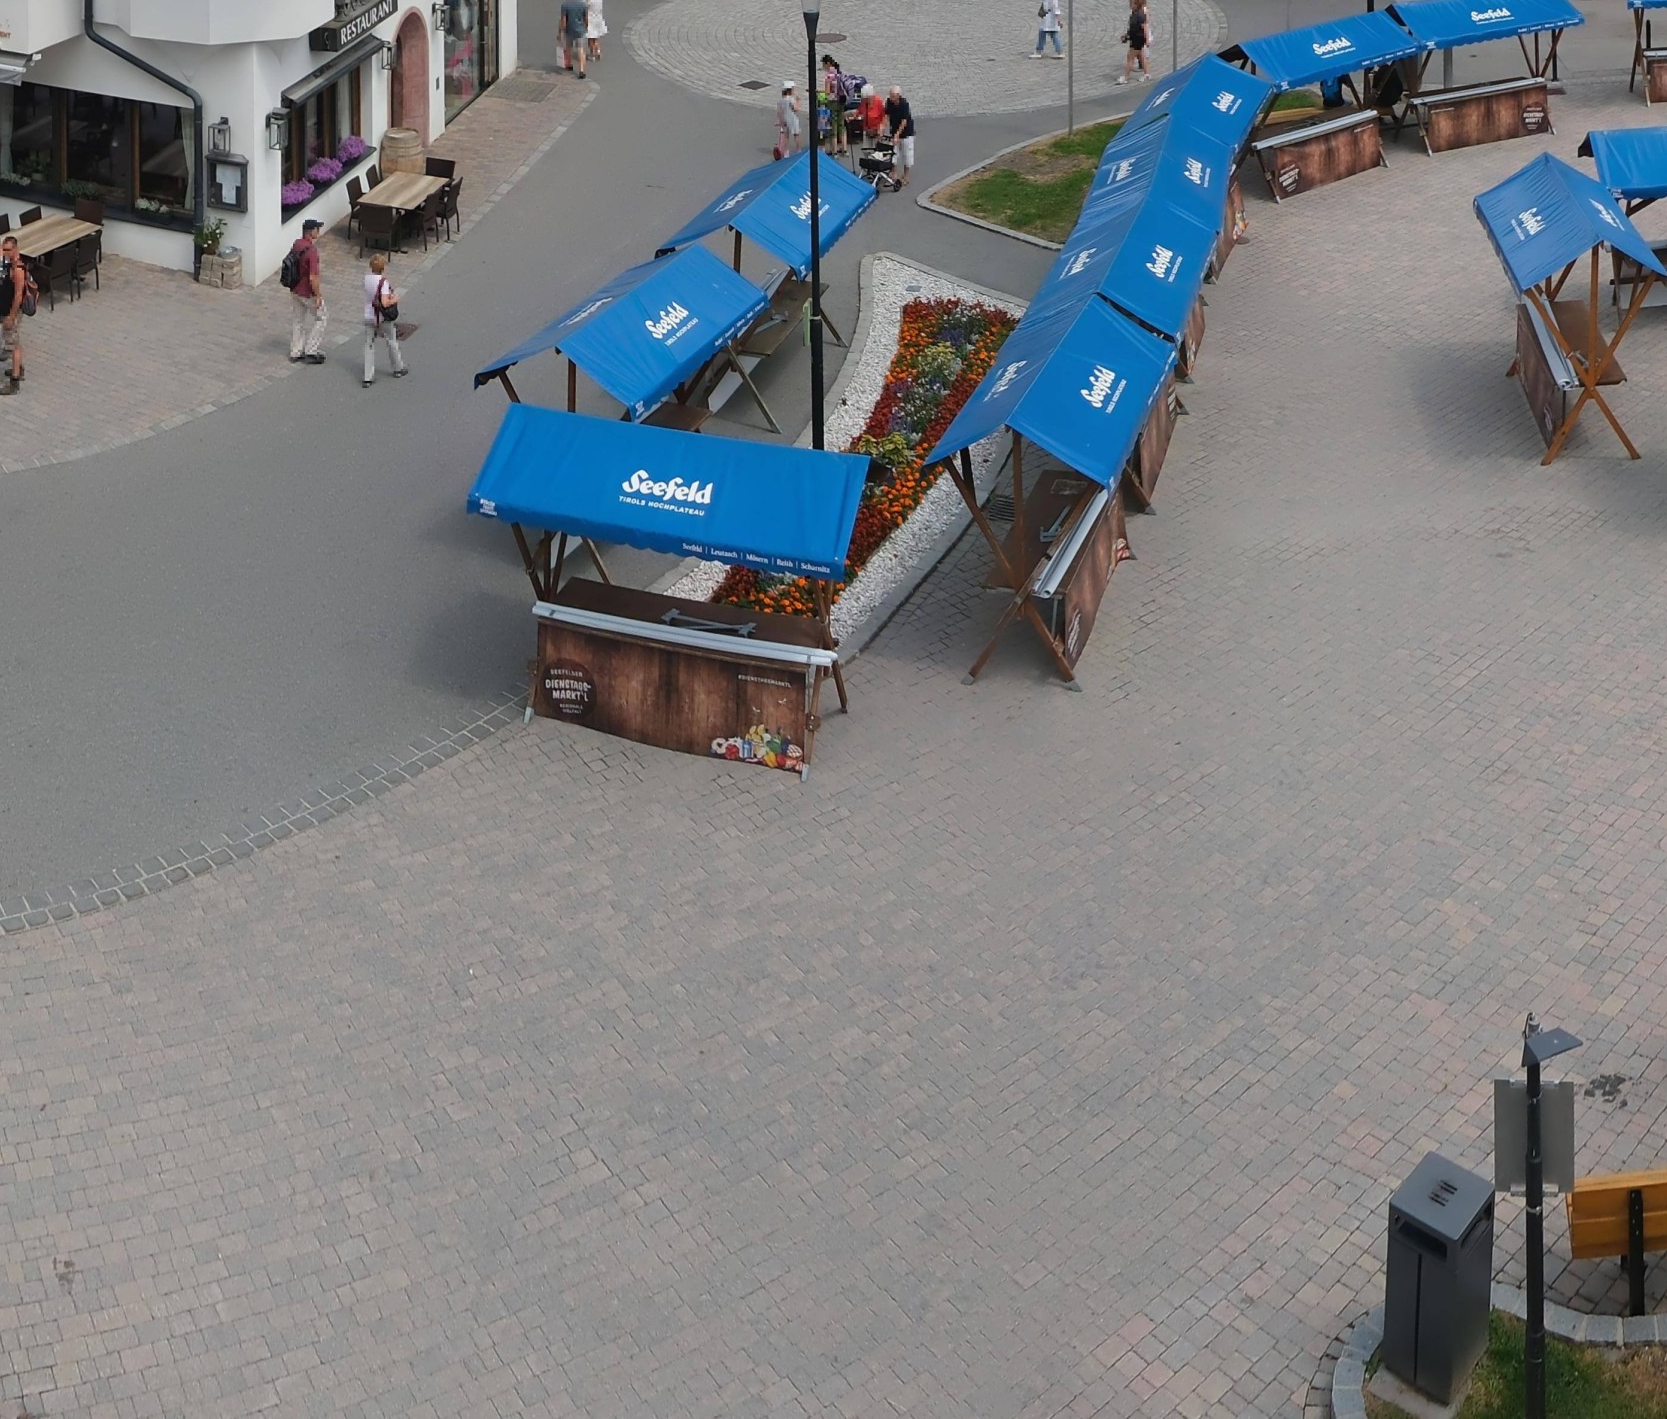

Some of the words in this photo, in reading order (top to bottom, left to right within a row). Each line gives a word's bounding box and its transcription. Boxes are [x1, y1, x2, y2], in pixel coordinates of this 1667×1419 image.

[1470, 7, 1511, 22] Seefeld
[1313, 37, 1351, 56] Seefeld
[1145, 244, 1173, 278] Seefeld
[644, 300, 689, 340] Seefeld
[1080, 364, 1116, 408] Seefeld
[622, 469, 714, 505] Seefeld
[619, 495, 646, 506] TIROLS
[648, 500, 705, 517] HOCHPLATEAU
[711, 547, 738, 559] Leutasch
[746, 553, 768, 564] Mösern
[776, 557, 793, 568] Reith
[800, 562, 830, 573] Scharnitz
